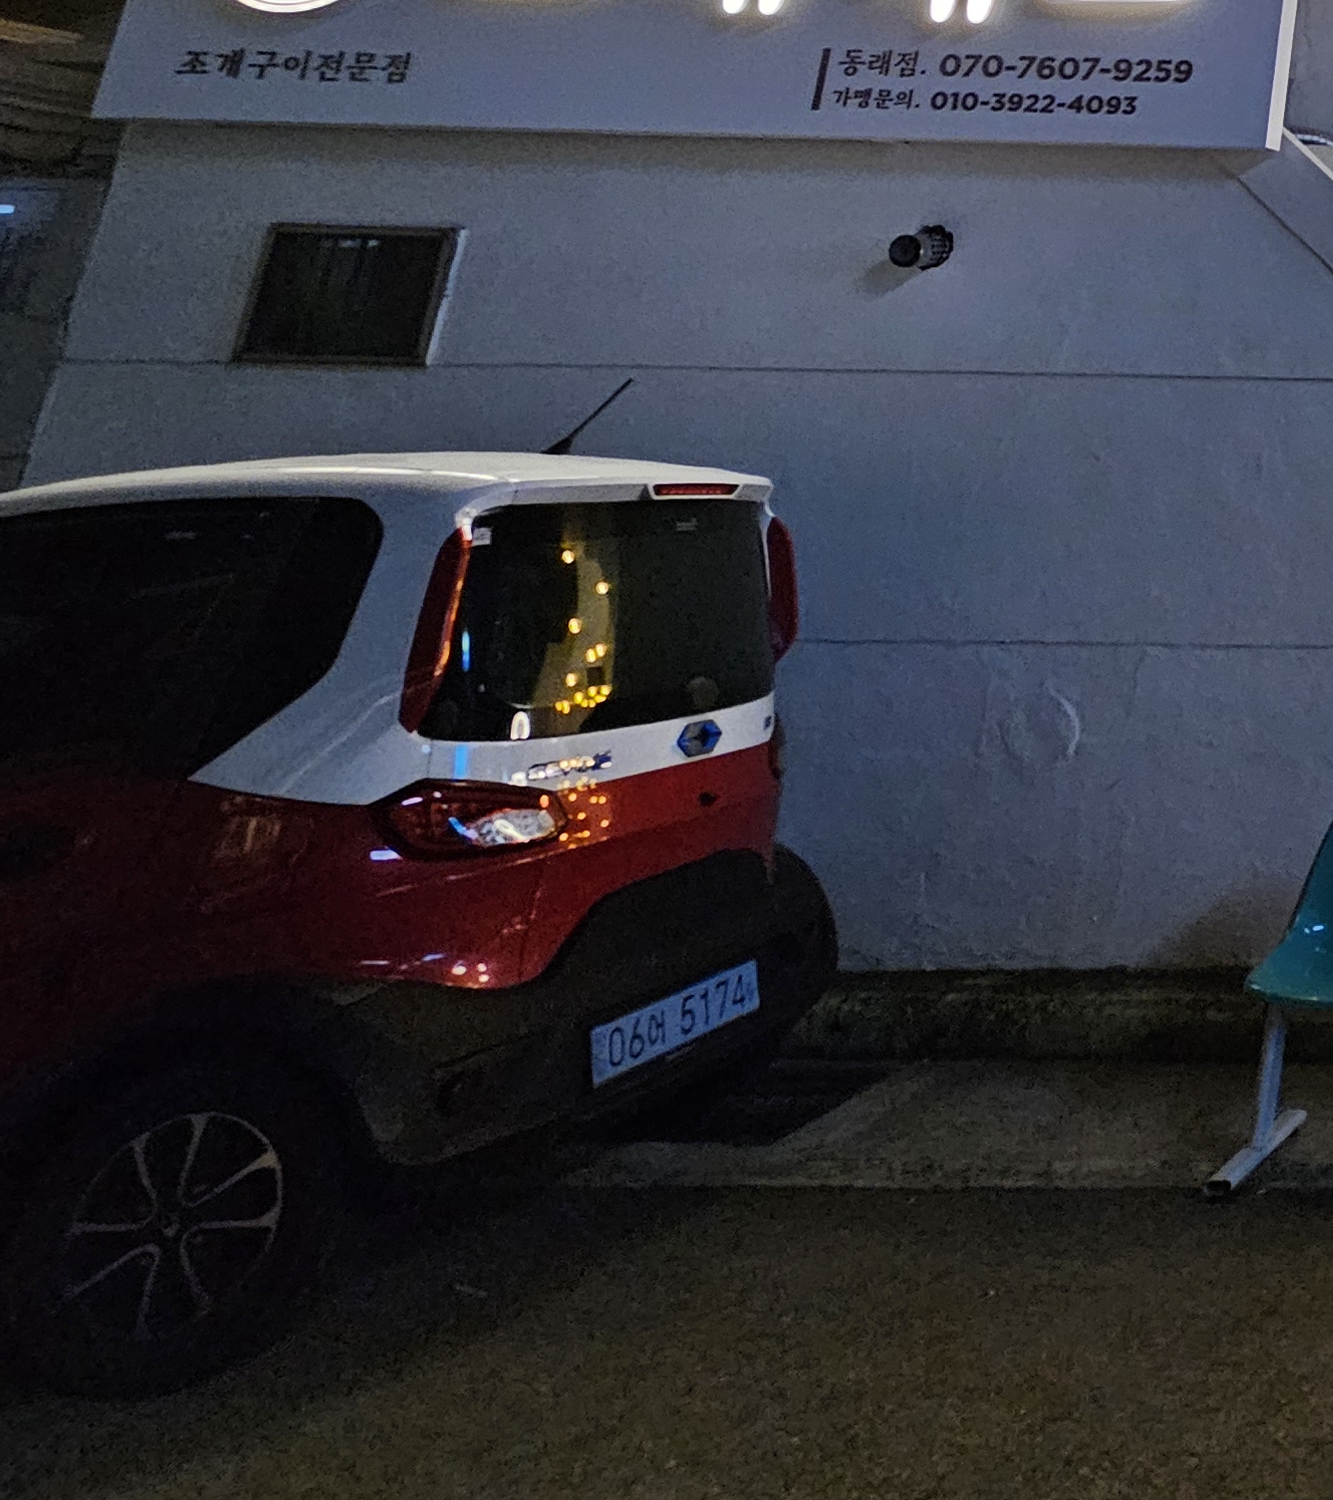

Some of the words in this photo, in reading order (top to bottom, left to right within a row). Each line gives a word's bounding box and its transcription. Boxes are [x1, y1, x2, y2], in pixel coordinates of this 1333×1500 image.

[174, 48, 412, 84] 조개구이전문점
[838, 49, 926, 78] 동래점.
[939, 53, 1194, 83] 070-7607-9259
[832, 87, 919, 110] 가맹문의.
[930, 91, 1138, 115] 010-3922-4093
[608, 1017, 666, 1067] 06어
[680, 974, 748, 1036] 5174
